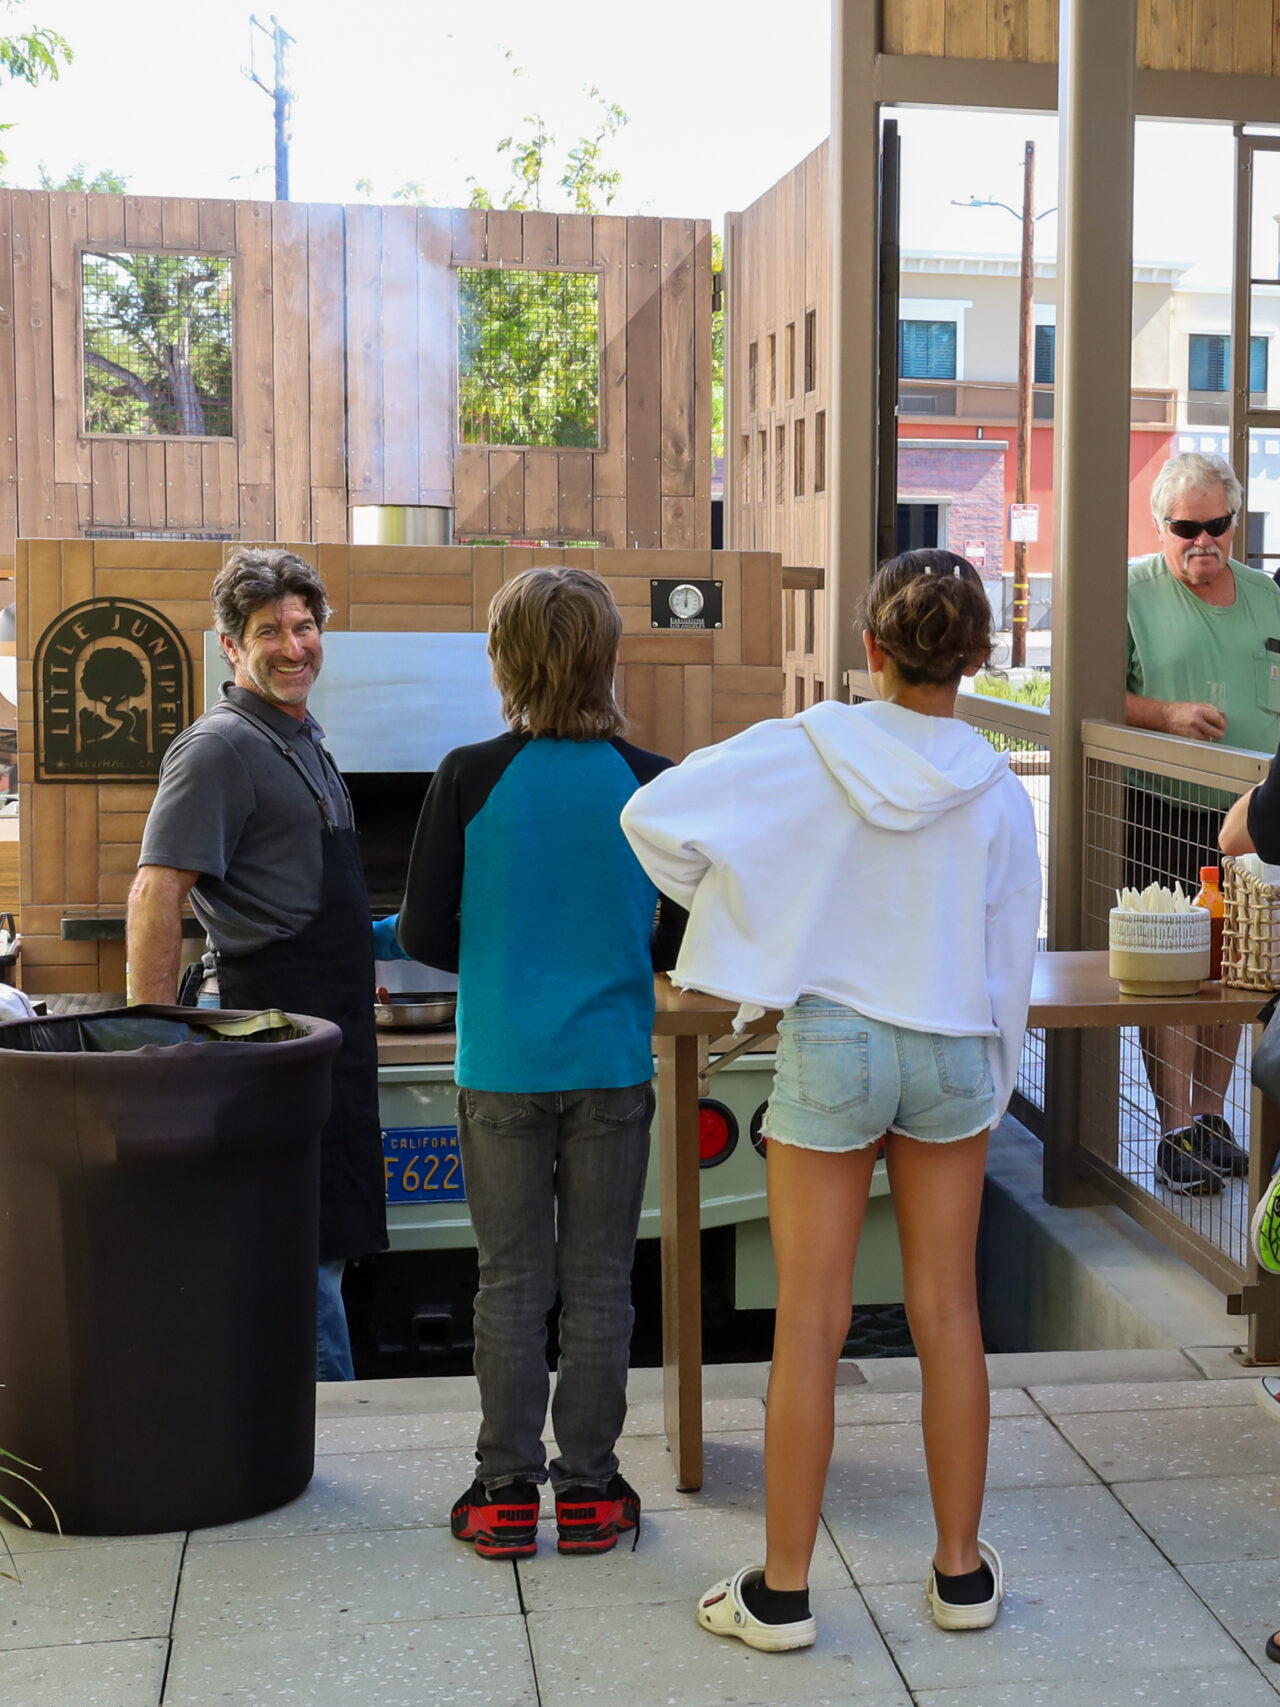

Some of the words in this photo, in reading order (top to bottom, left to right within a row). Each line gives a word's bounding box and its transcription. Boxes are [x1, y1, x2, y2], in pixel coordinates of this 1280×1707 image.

[50, 621, 91, 735] LITTLE
[112, 613, 177, 735] JUNIPER
[384, 1154, 460, 1191] F622
[497, 1509, 534, 1521] PUMA
